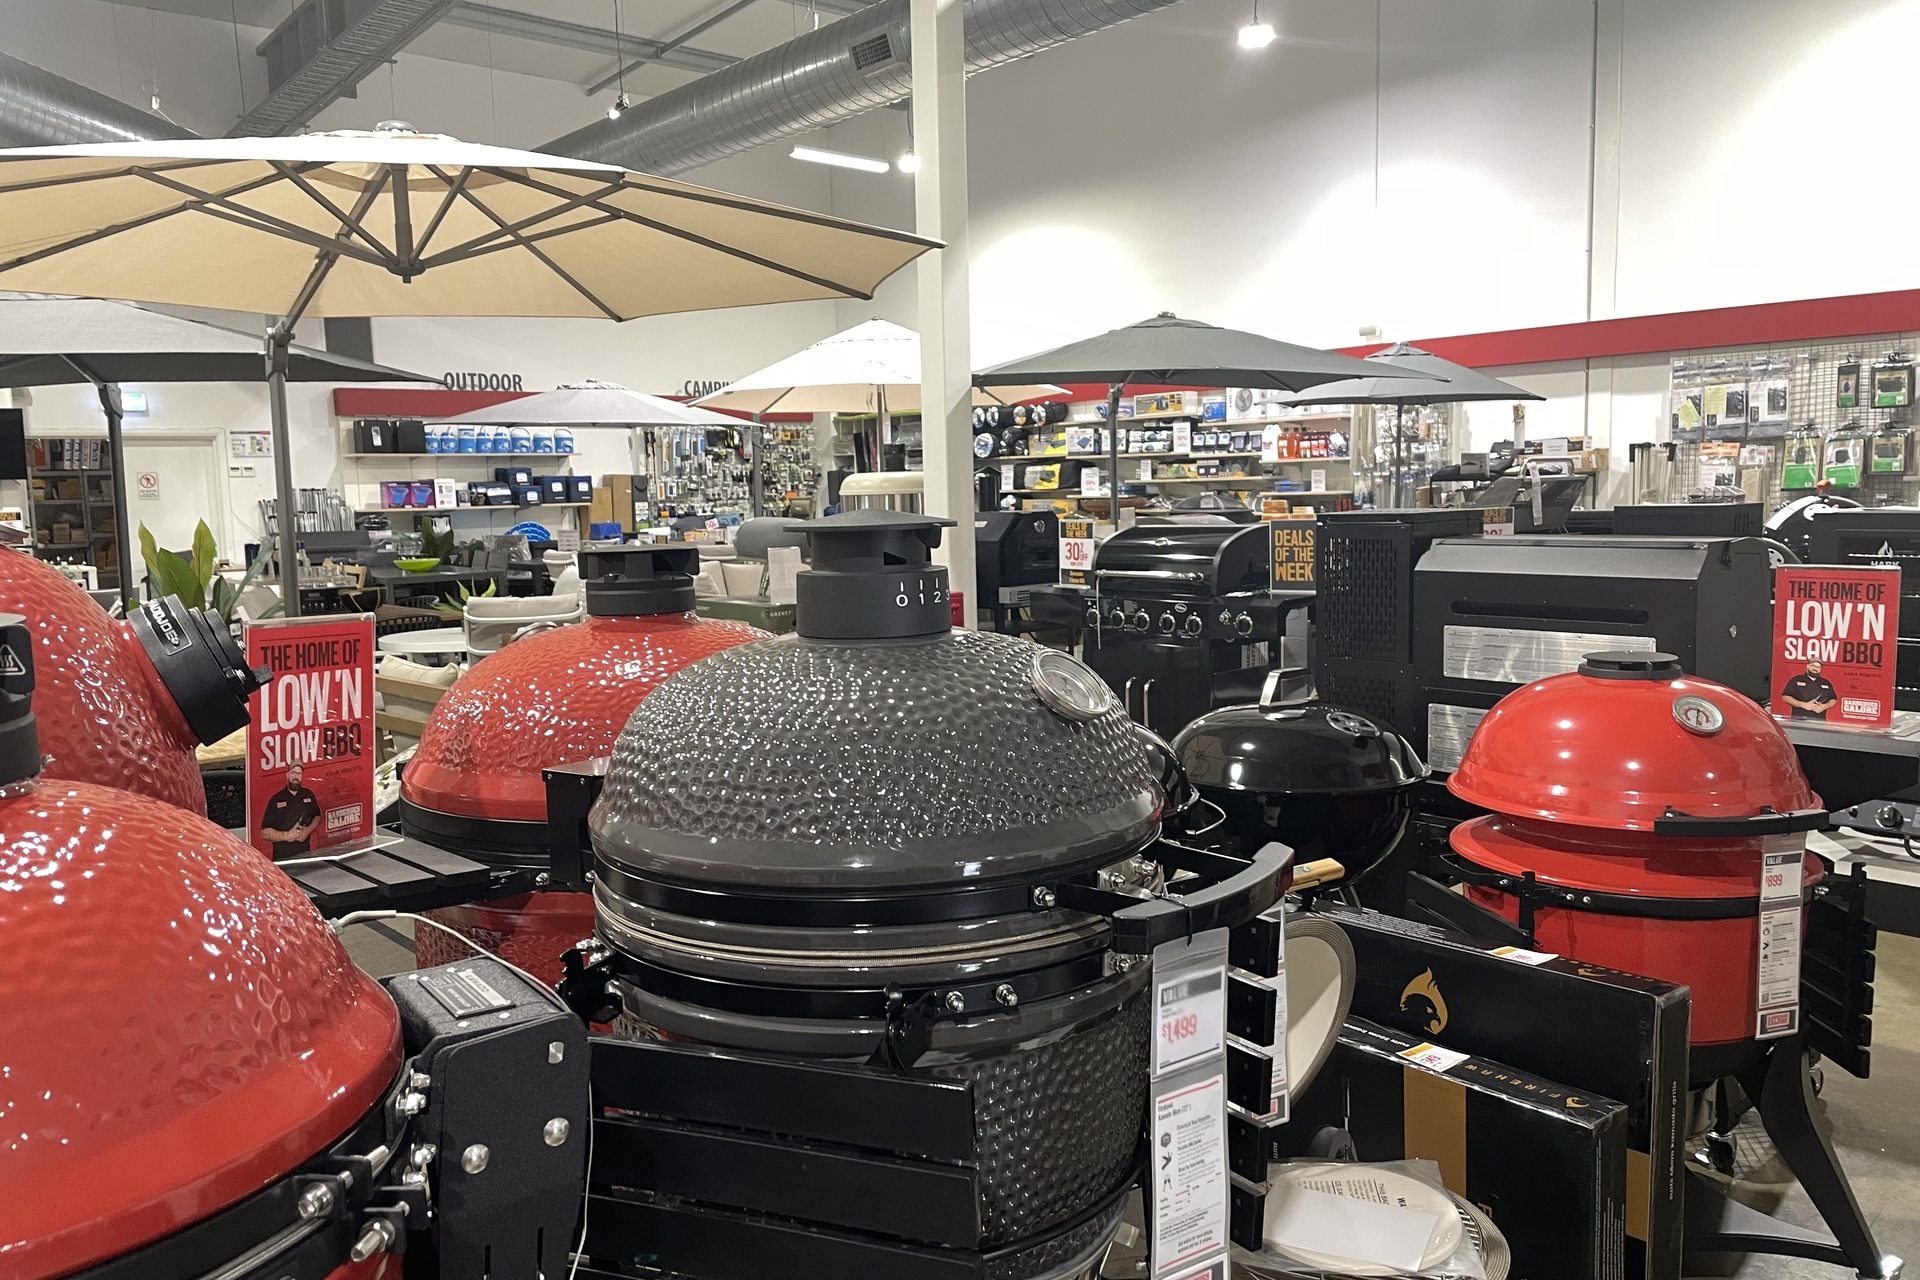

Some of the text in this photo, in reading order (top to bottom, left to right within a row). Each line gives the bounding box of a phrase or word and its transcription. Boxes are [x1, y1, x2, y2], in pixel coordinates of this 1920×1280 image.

[443, 372, 523, 392] OUTDOOR
[1275, 530, 1314, 546] DEALS
[1275, 547, 1314, 562] OF THE
[1275, 563, 1314, 581] WEEK
[919, 592, 925, 605] 1
[933, 591, 942, 603] 2
[1789, 581, 1885, 601] THE HOME OF
[260, 639, 360, 672] THE HOME OF
[1784, 637, 1883, 667] SLOW BBQ
[1844, 705, 1878, 714] GALORE
[261, 722, 362, 771] SLOW BBQ
[327, 812, 361, 829] GALORE
[1161, 1013, 1198, 1044] $1,499
[1459, 1062, 1562, 1099] FIREHAW
[1377, 1183, 1386, 1195] THIS
